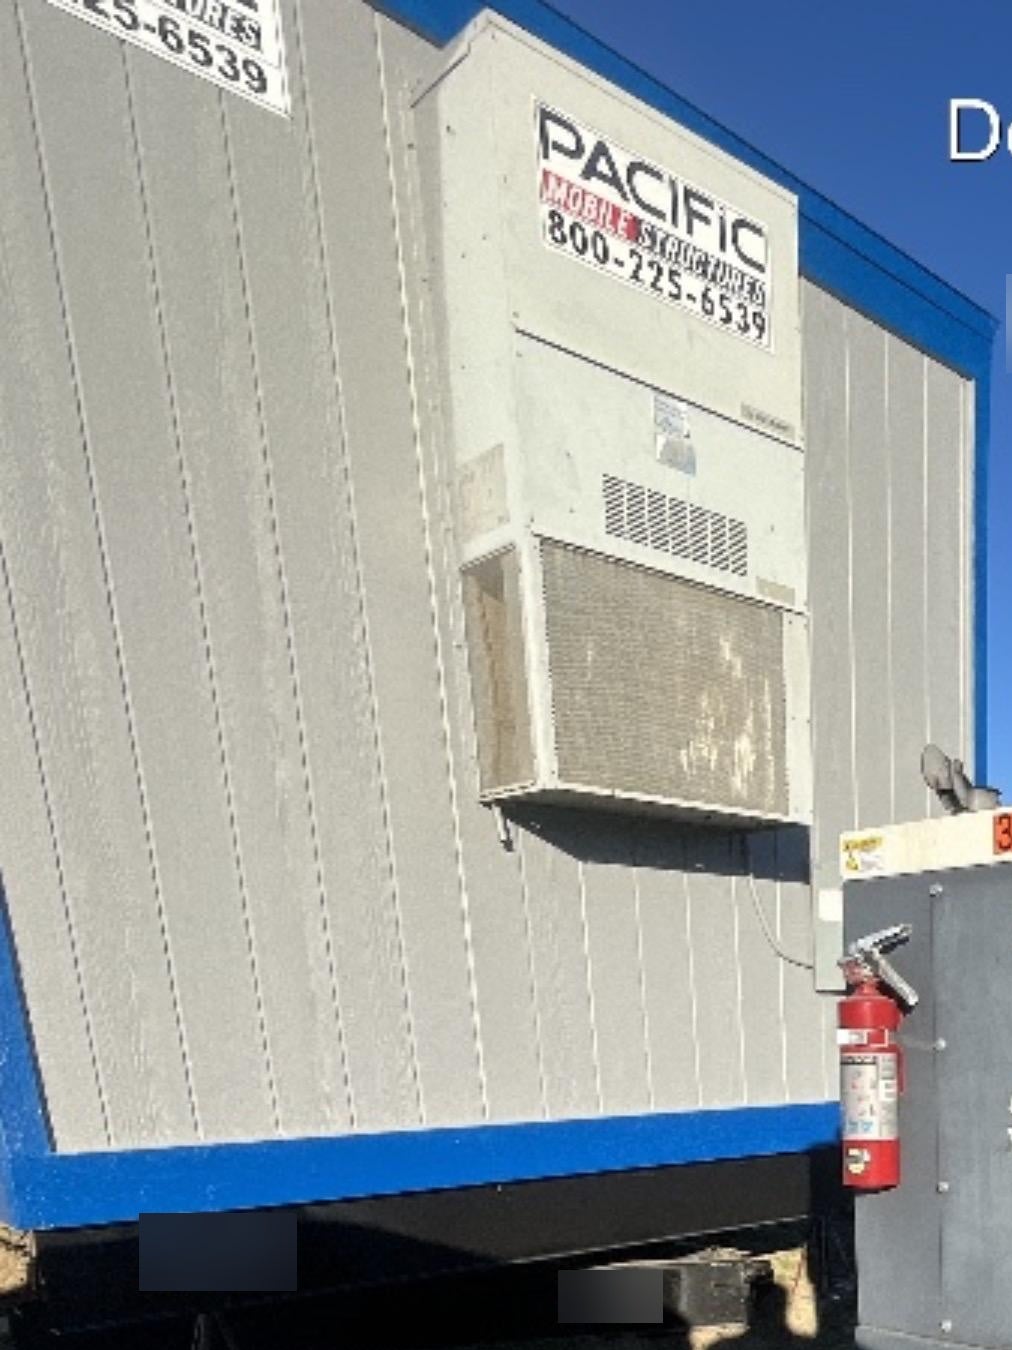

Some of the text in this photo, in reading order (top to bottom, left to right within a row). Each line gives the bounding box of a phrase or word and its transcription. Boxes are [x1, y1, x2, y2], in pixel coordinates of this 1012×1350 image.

[540, 105, 766, 274] PACIFIC
[541, 169, 638, 243] MOBILE
[548, 209, 766, 340] 800-225-6539
